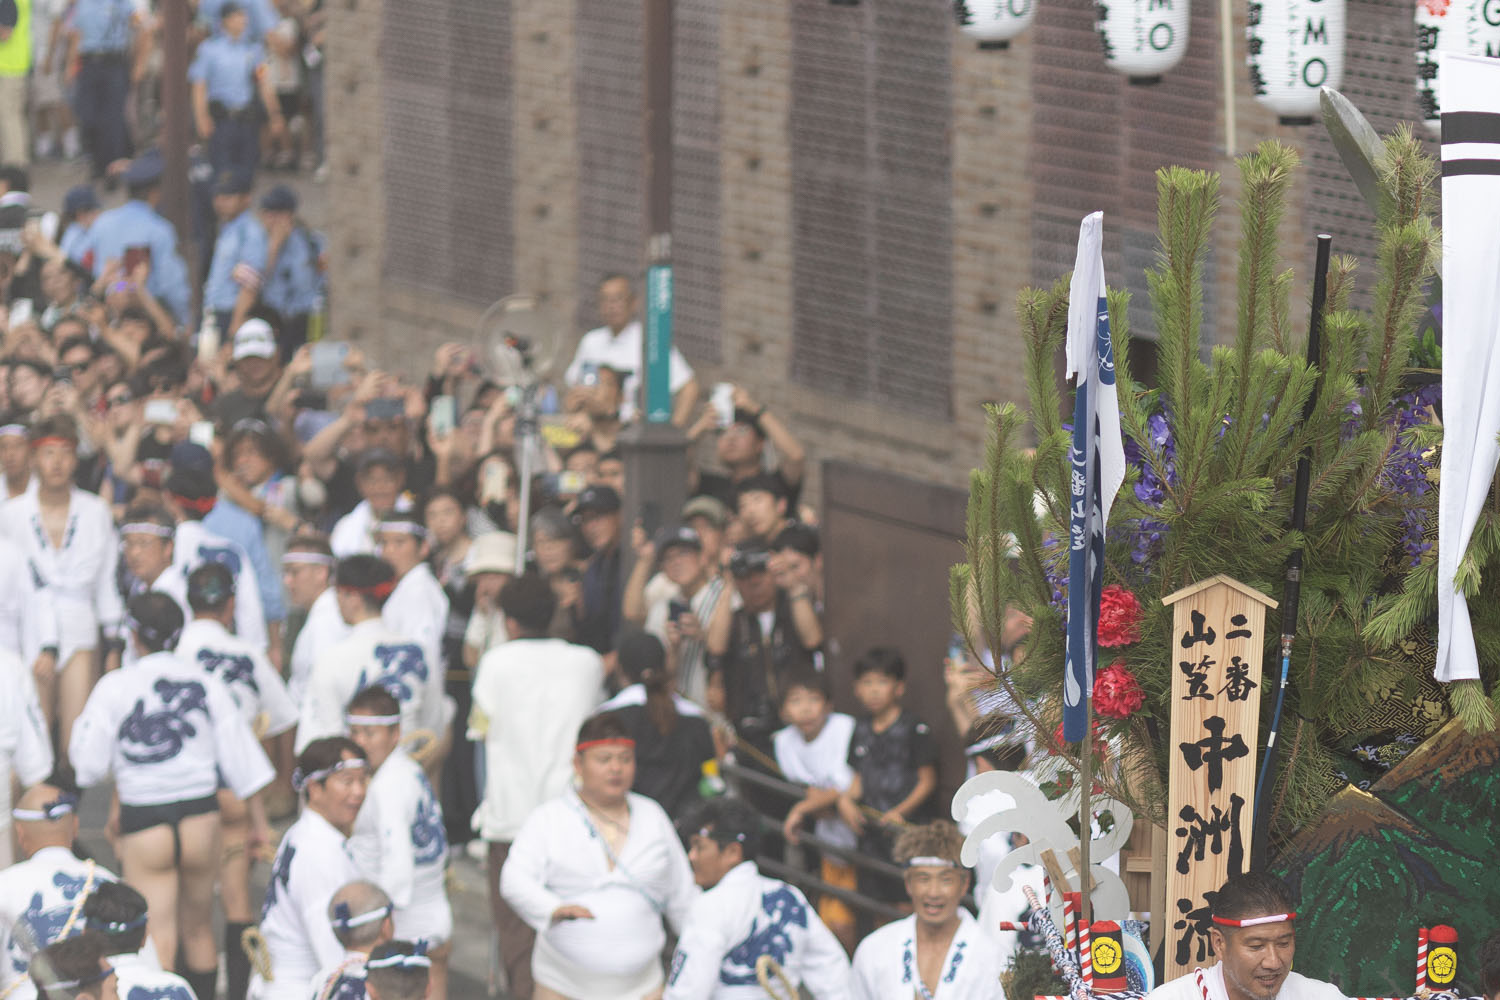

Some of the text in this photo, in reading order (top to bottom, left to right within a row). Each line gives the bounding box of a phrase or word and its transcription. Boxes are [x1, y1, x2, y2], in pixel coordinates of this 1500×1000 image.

[1302, 0, 1328, 87] MO
[1179, 609, 1217, 702] 山笠
[1217, 613, 1258, 703] 二番
